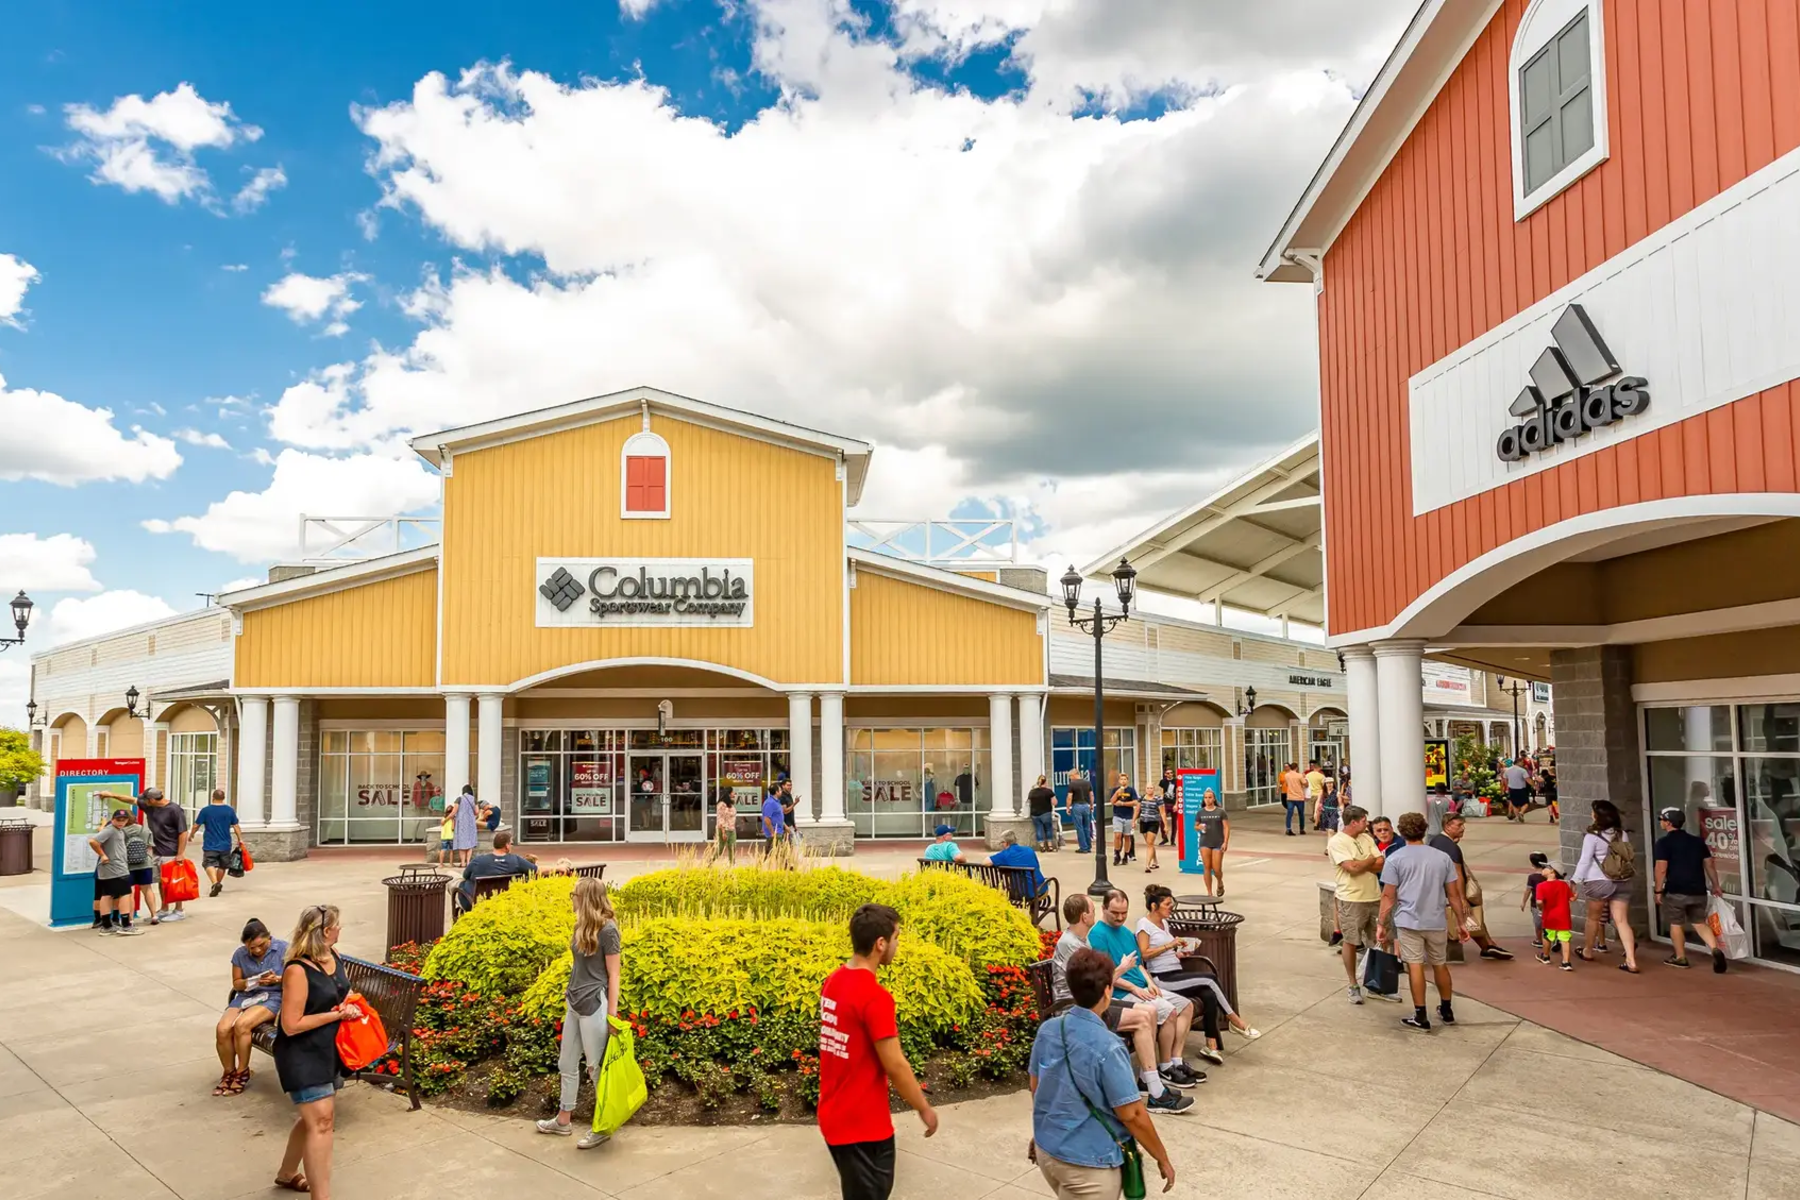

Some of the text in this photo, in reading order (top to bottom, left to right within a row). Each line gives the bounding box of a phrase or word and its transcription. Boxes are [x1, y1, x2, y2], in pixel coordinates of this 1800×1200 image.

[1497, 376, 1650, 461] adidas
[588, 566, 749, 599] Columbia
[589, 598, 746, 618] Sportswear Company
[1289, 675, 1332, 687] AMERICAN EAGLE
[60, 769, 109, 777] DIRECTORY
[358, 790, 411, 806] SALE
[736, 795, 758, 806] ALE
[862, 786, 911, 802] SALE
[576, 797, 606, 807] SALE
[530, 819, 546, 827] SALE
[1705, 815, 1737, 830] sale
[1710, 850, 1738, 860] torewide
